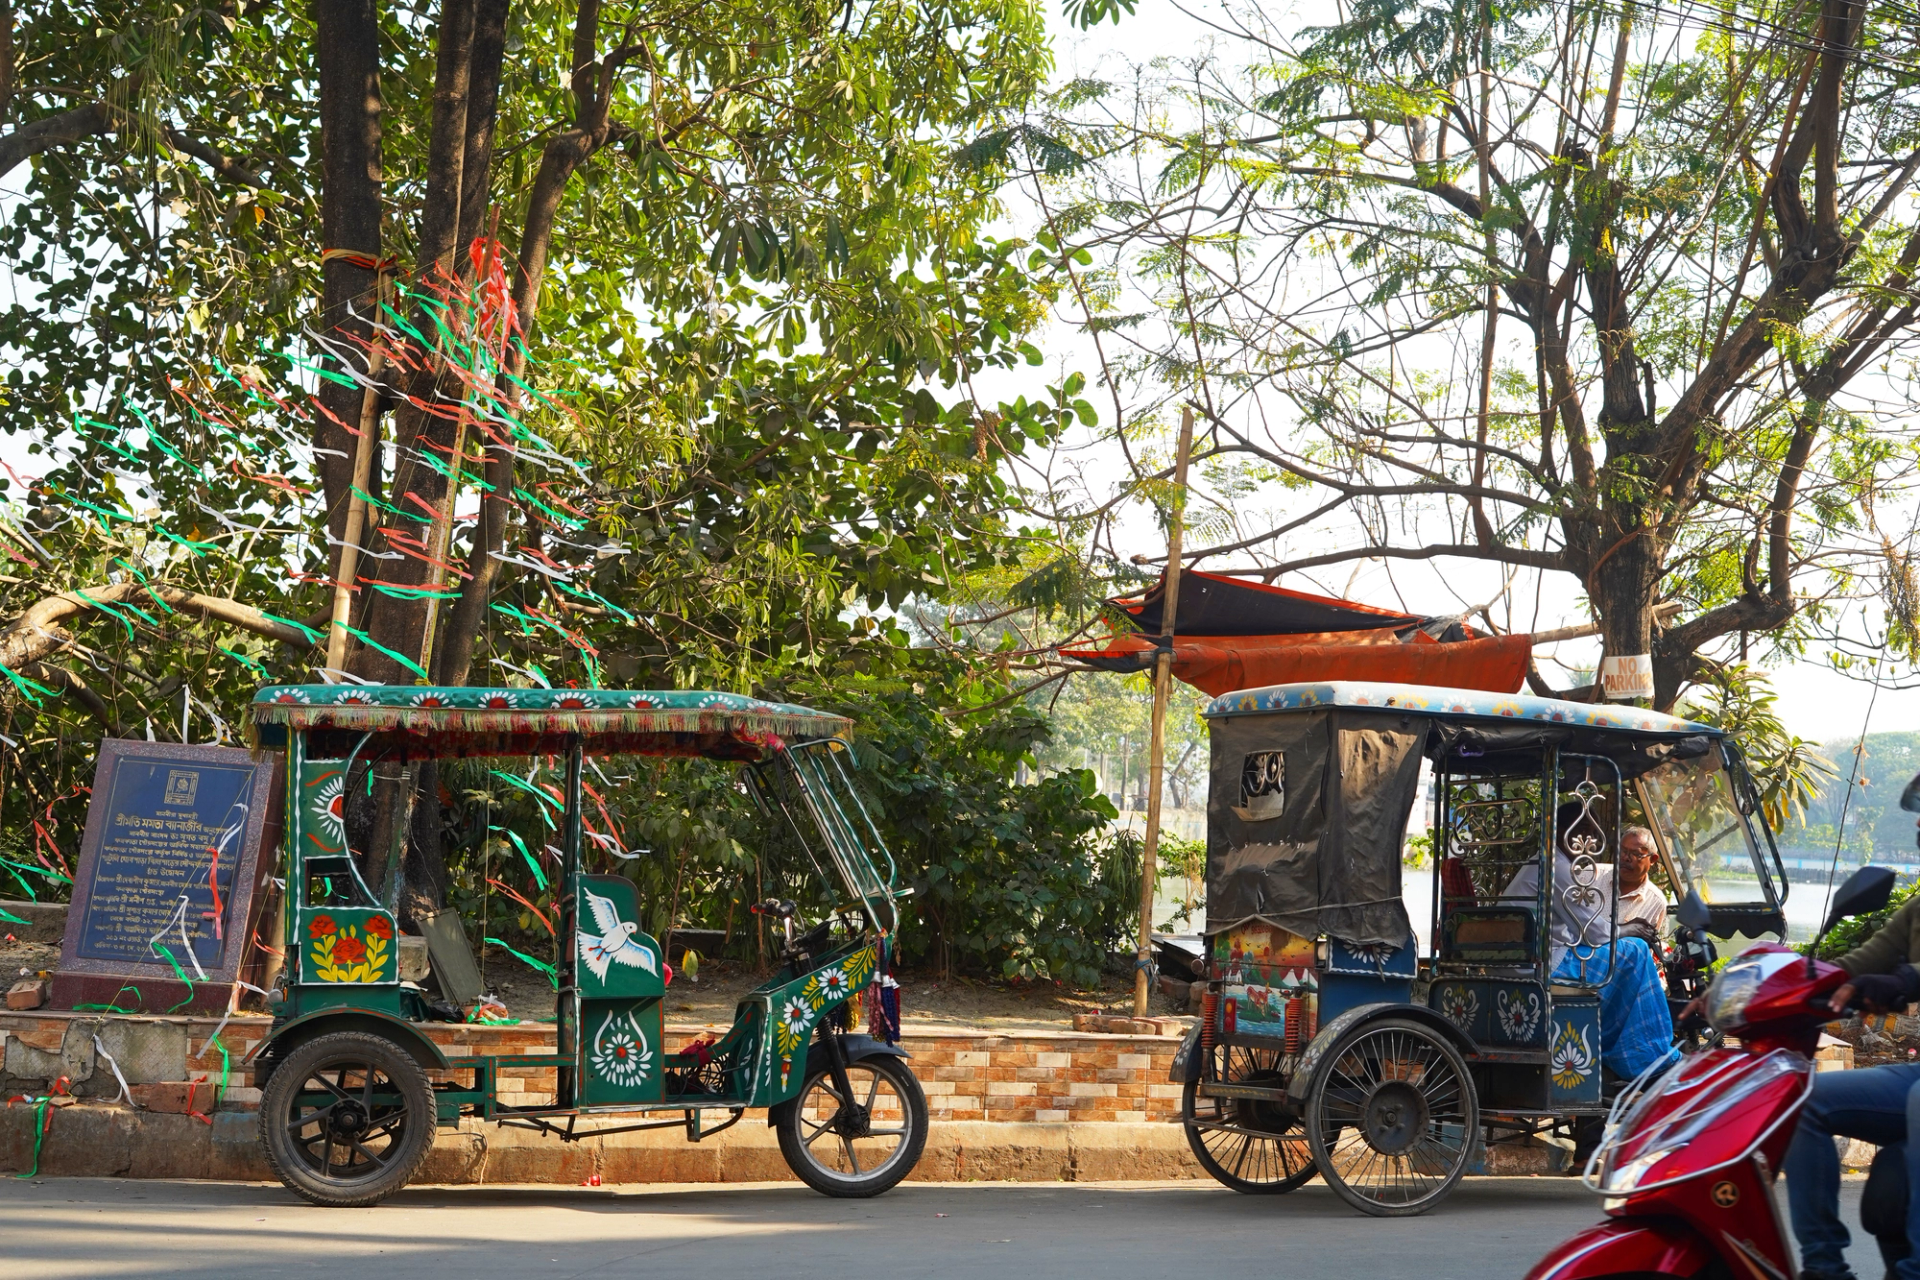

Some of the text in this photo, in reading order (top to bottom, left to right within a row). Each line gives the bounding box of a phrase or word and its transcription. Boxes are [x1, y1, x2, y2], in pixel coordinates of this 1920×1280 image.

[1618, 657, 1637, 675] NO
[115, 813, 141, 827] শ্রীমতি
[142, 818, 164, 830] মমতা
[120, 893, 128, 903] শ্রী
